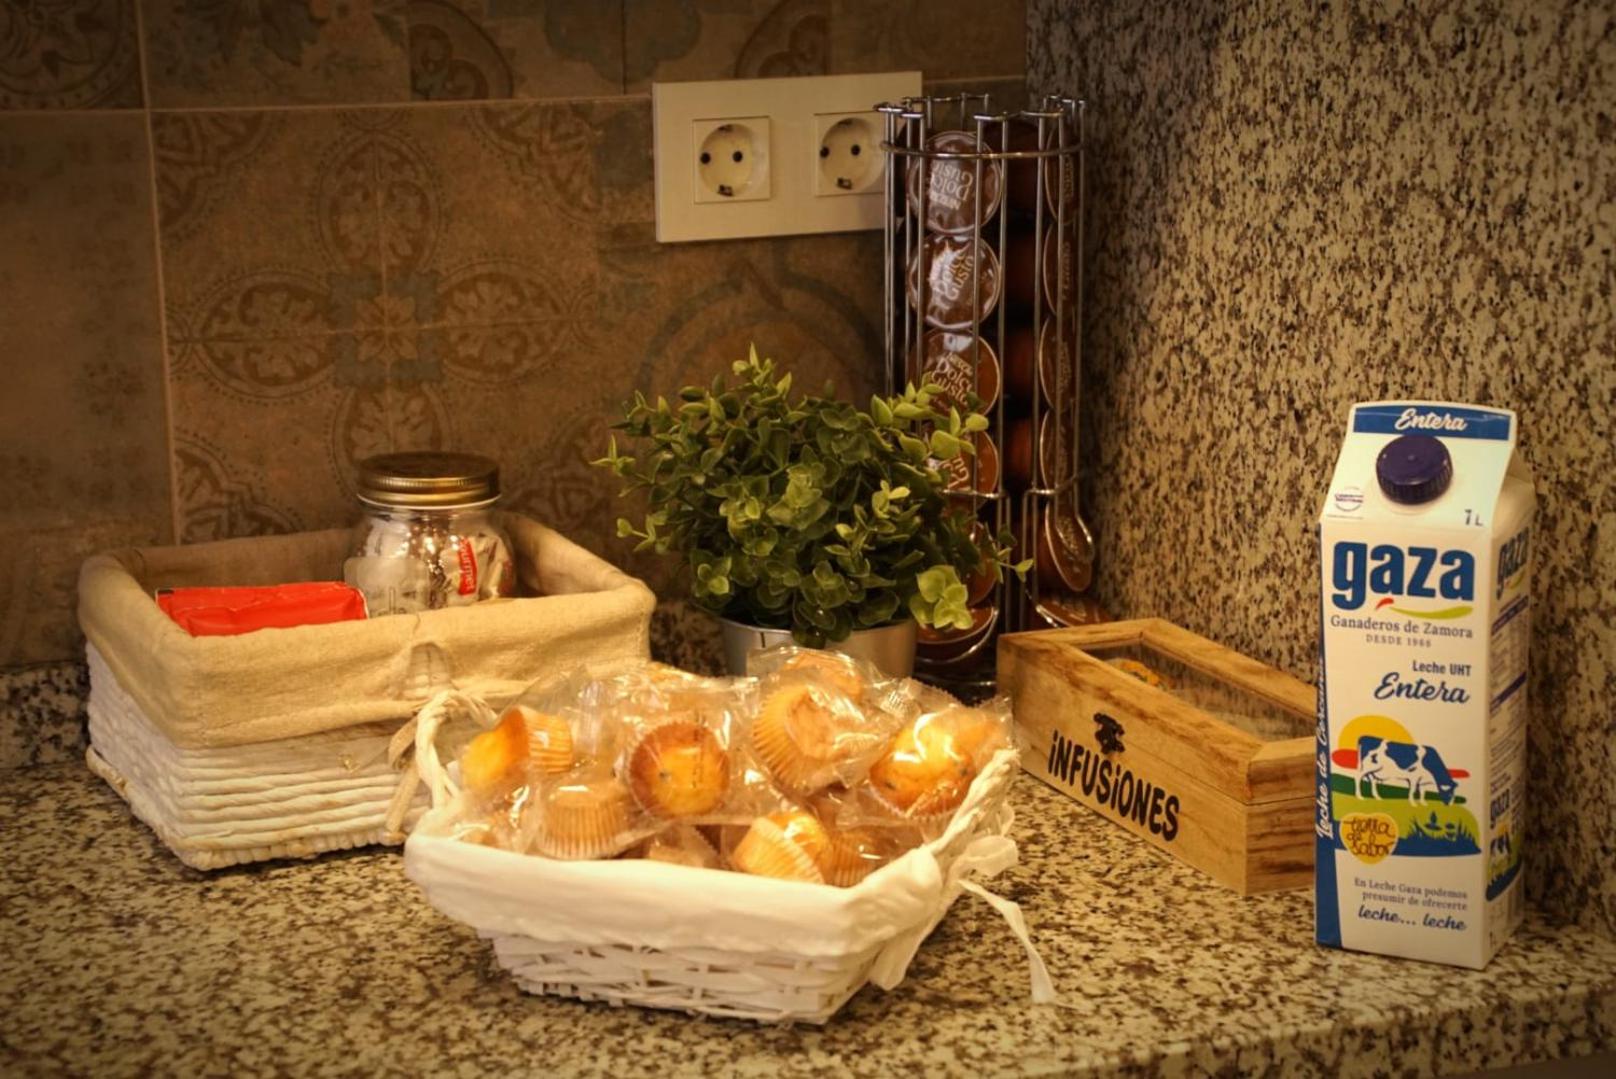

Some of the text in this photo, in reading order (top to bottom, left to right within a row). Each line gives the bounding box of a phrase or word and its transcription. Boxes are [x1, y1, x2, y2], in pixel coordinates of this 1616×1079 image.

[1394, 408, 1468, 432] Entera
[459, 539, 475, 590] ourmet
[1332, 541, 1475, 610] gaza
[1330, 614, 1473, 638] Ganaderos de Zamora
[1413, 660, 1472, 677] Leche UHT
[1374, 672, 1471, 704] Entera
[1354, 877, 1468, 899] En Leche Gaza podemos
[1362, 891, 1468, 911] presumir de ofrecerte
[1423, 913, 1467, 931] leche
